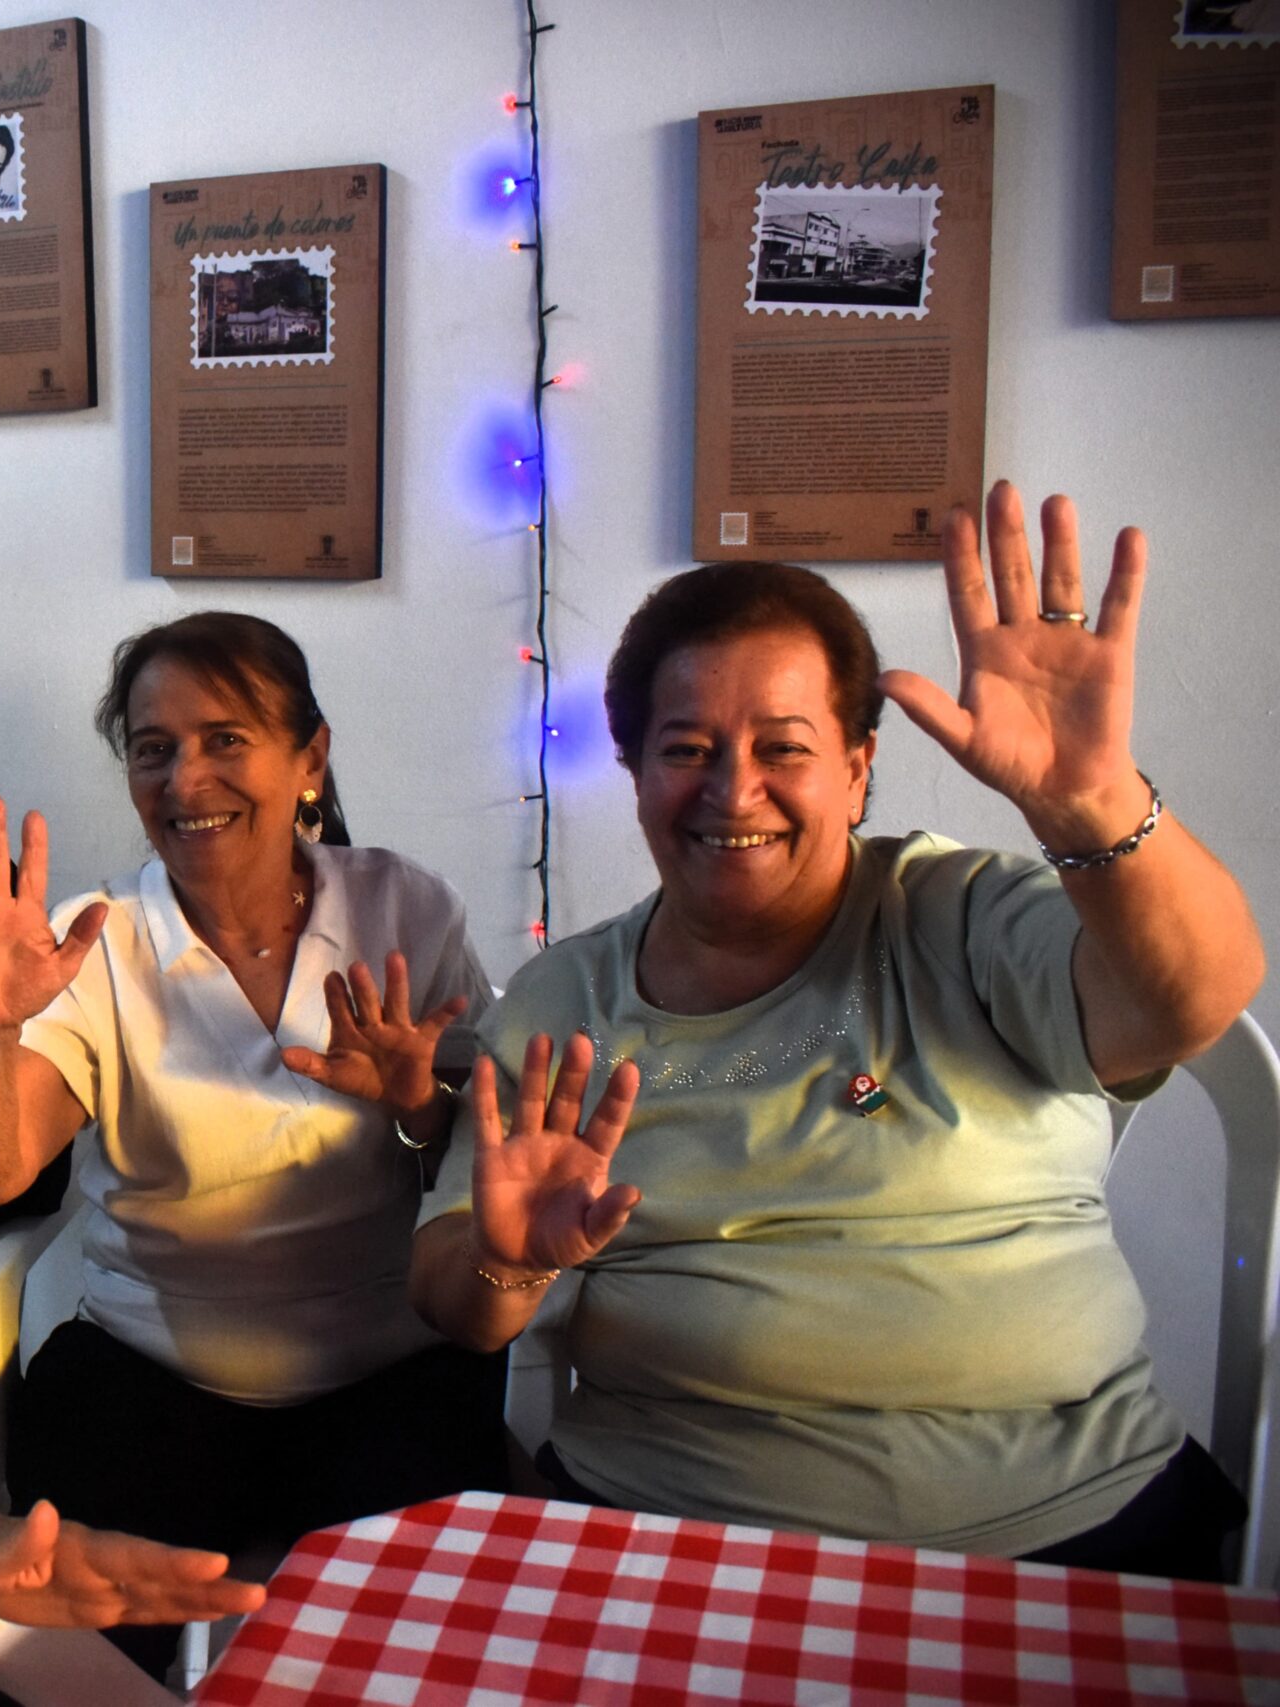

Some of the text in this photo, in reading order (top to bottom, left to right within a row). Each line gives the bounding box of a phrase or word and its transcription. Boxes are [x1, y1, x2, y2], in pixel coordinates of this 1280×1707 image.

[762, 144, 846, 190] Teatro
[174, 200, 357, 249] Un puente de colores
